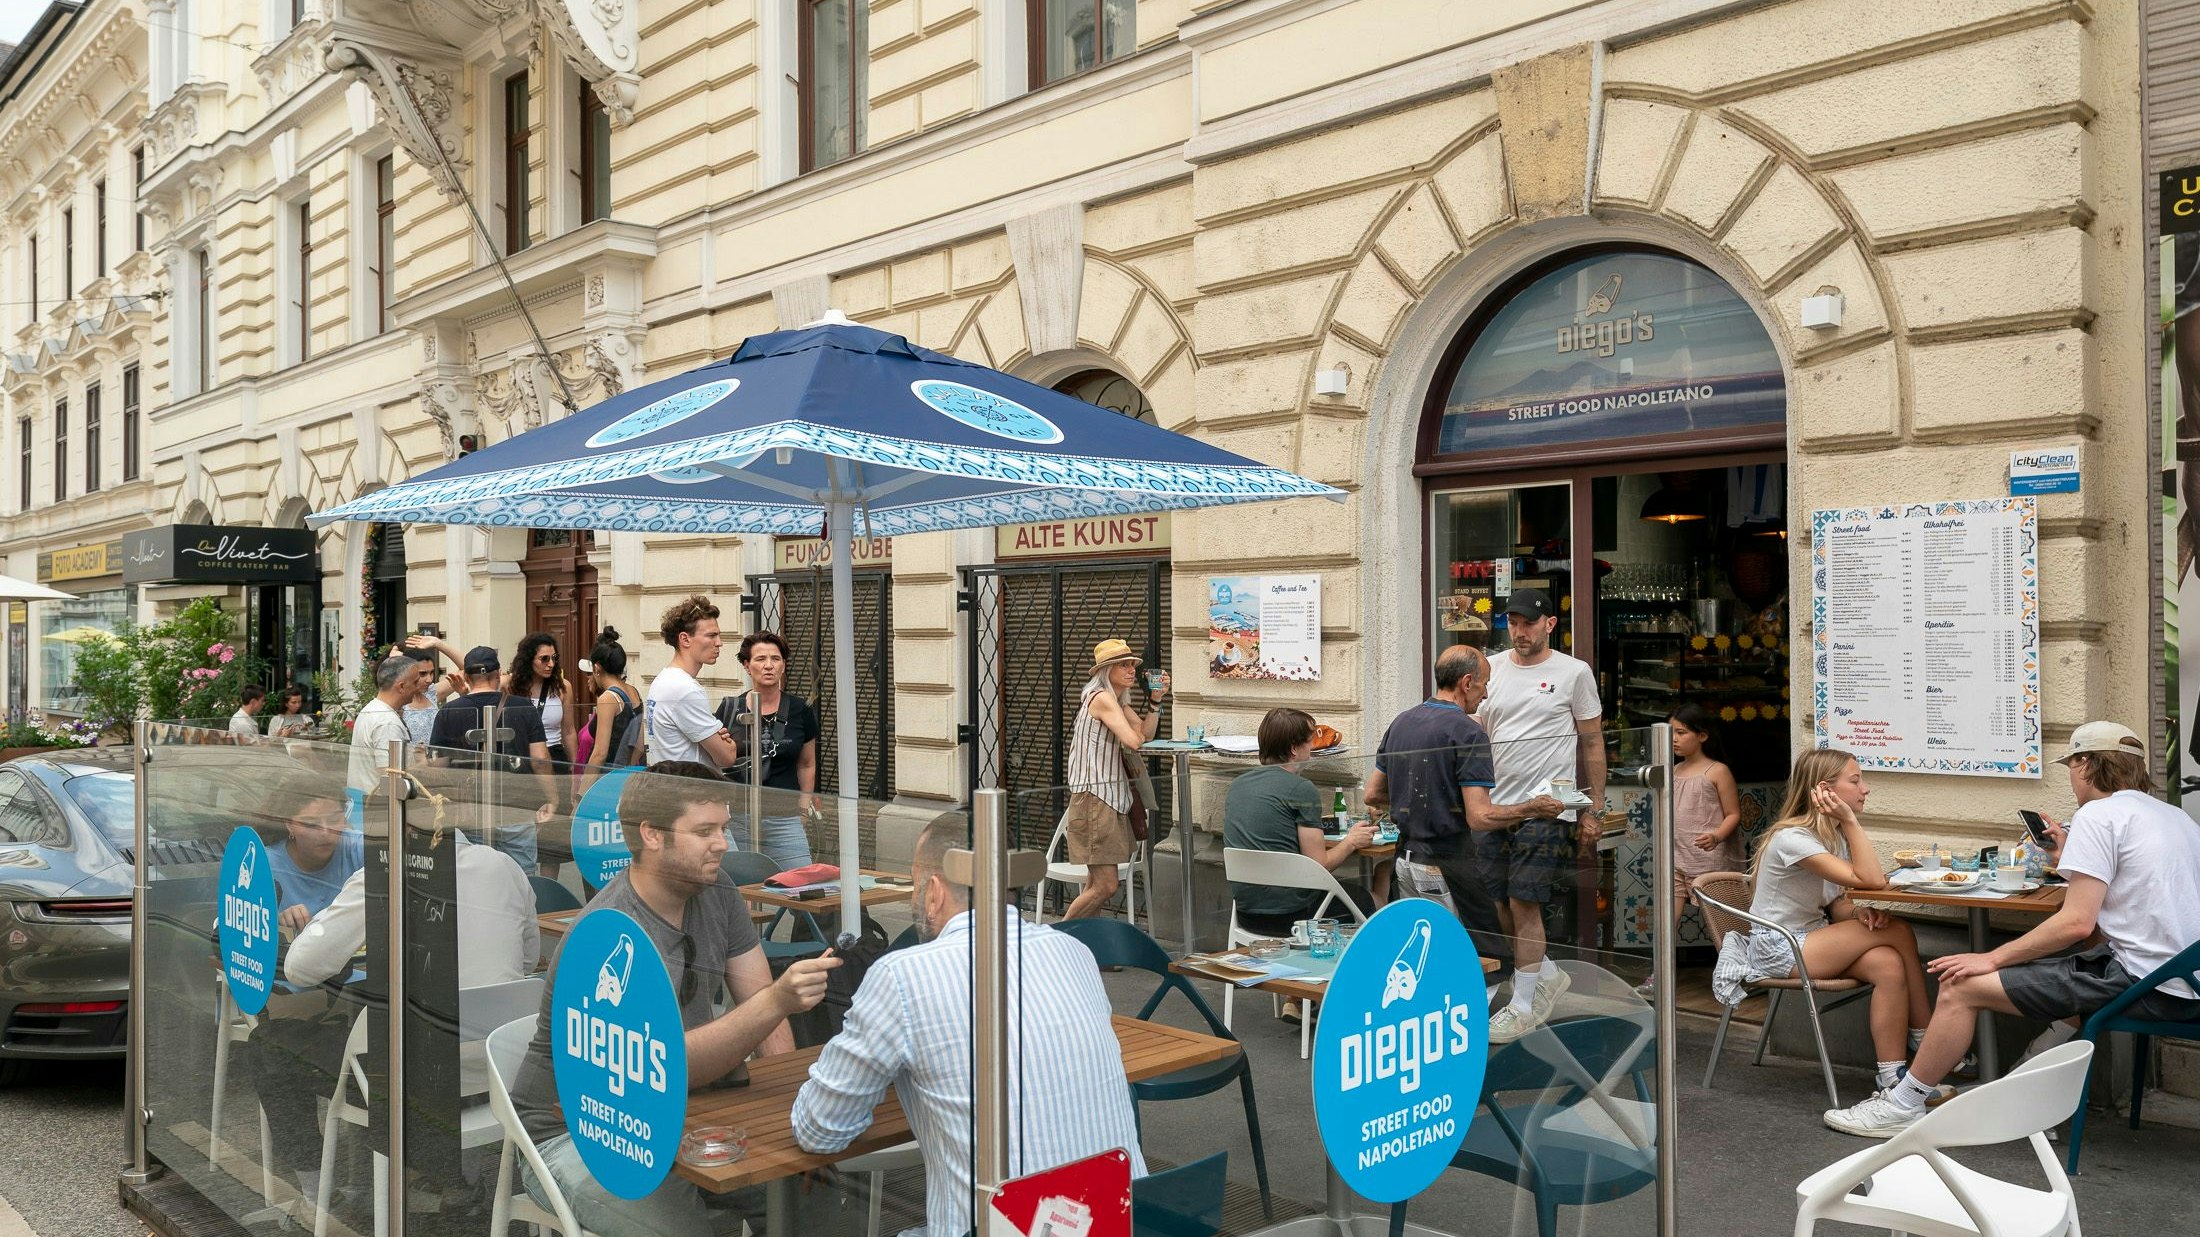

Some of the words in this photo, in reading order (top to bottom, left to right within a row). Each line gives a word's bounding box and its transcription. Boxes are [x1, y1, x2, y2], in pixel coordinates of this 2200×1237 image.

[1508, 404, 1555, 421] STREET
[1558, 399, 1602, 416] FOOD
[1604, 385, 1714, 410] NAPOLETANO
[1015, 523, 1065, 550] ALTE
[1074, 517, 1159, 546] KUNST
[1832, 525, 1854, 534] Street
[1923, 519, 1965, 530] Alkoholfrei
[55, 554, 71, 574] FOTO
[72, 549, 103, 572] ACADEMY
[198, 560, 233, 568] COFFEE
[786, 537, 892, 564] FUNDRUBE
[1833, 642, 1856, 650] Panini
[1926, 685, 1944, 693] Bier
[1927, 737, 1948, 745] Wein
[224, 884, 270, 949] Diego's
[231, 950, 248, 968] STREET
[248, 957, 264, 975] FOOD
[230, 968, 264, 992] NAPOLETANO
[567, 996, 667, 1097] Diego's
[1340, 994, 1469, 1095] Diego's
[580, 1094, 617, 1126] STREET
[617, 1111, 652, 1140] FOOD
[1361, 1108, 1409, 1143] STREET
[1412, 1094, 1453, 1123] FOOD
[577, 1117, 655, 1169] NAPOLETANO
[1358, 1118, 1455, 1172] NAPOLETANO
